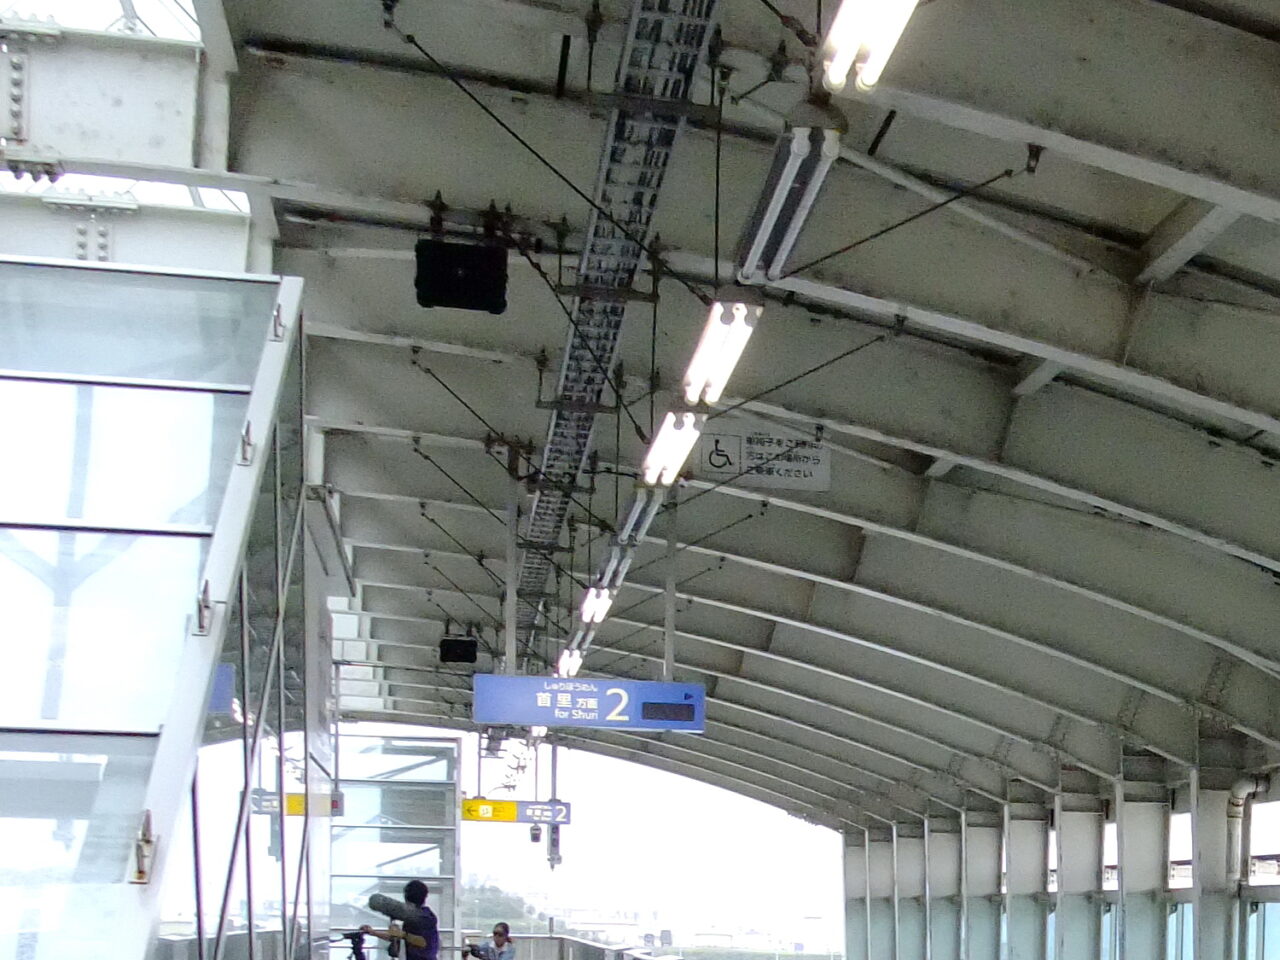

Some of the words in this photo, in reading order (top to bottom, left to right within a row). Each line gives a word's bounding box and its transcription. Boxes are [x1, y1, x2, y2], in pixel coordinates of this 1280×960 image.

[605, 688, 629, 721] 2
[554, 708, 569, 719] for
[572, 709, 598, 720] Shuri
[555, 806, 567, 822] 2
